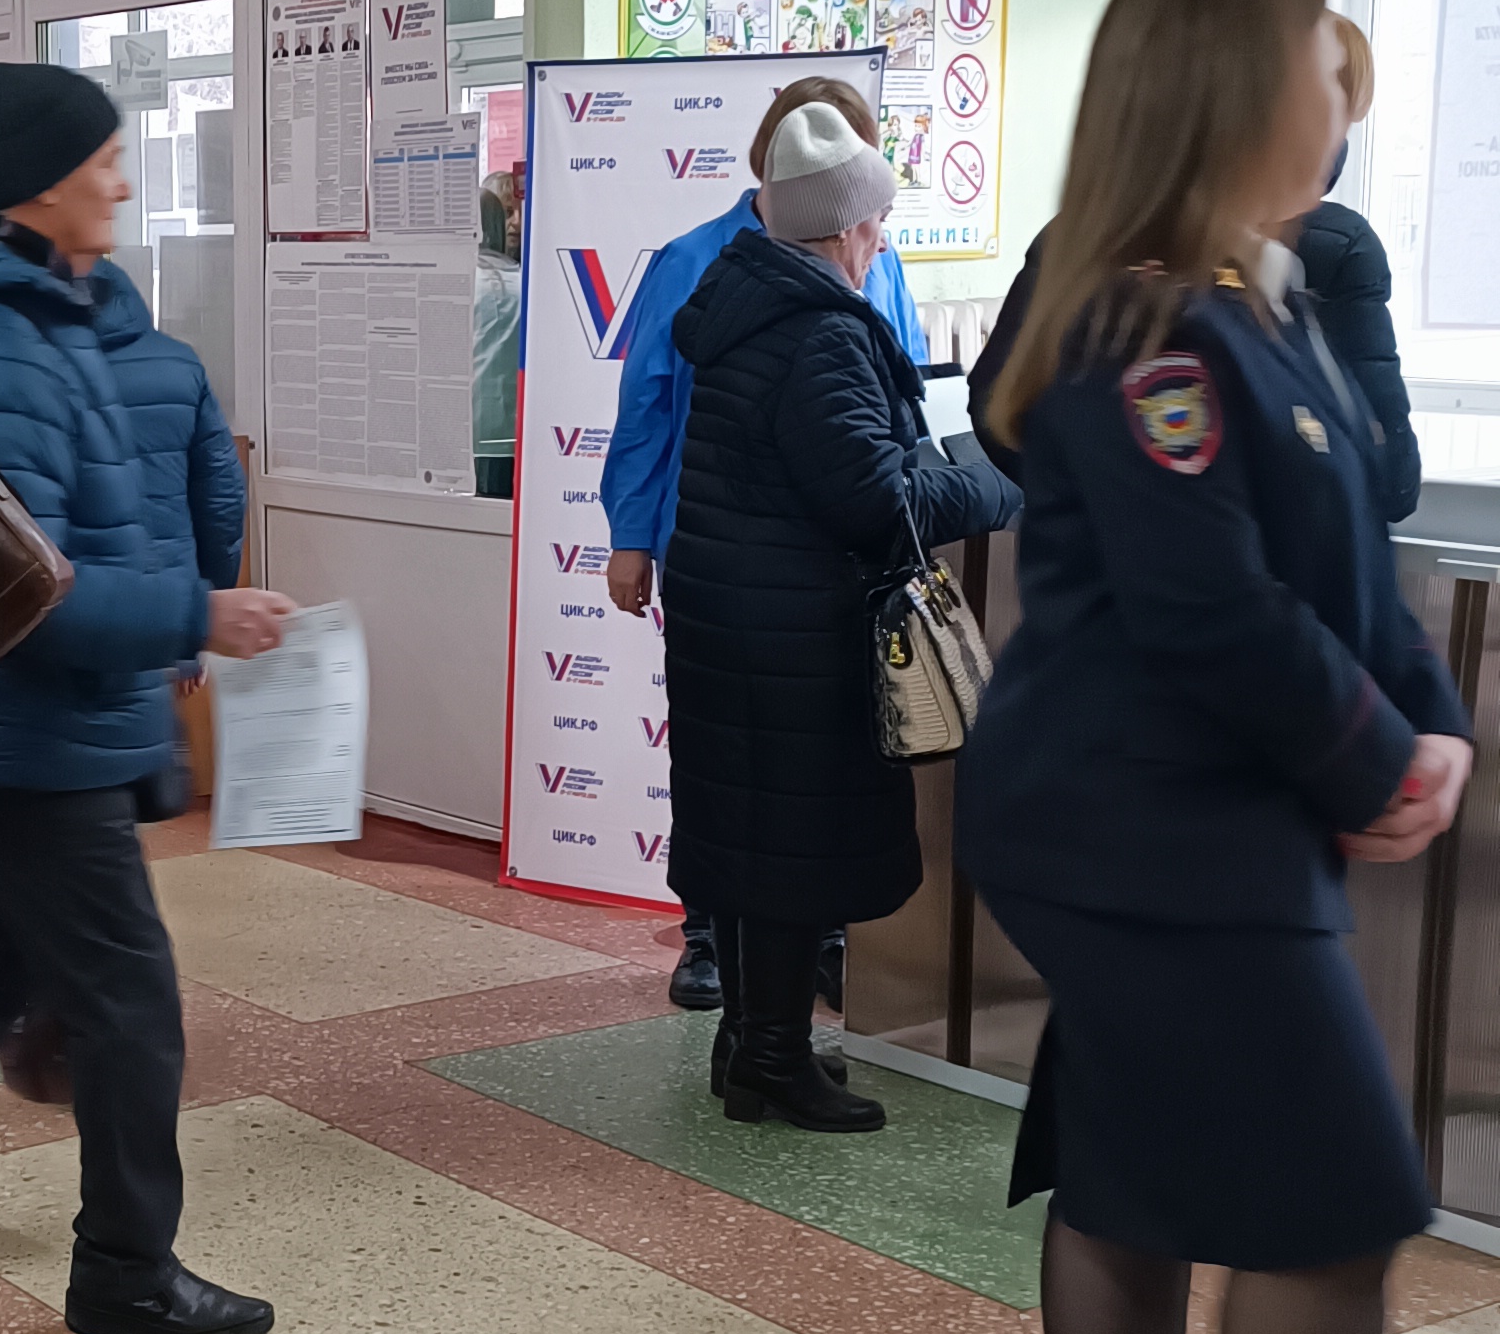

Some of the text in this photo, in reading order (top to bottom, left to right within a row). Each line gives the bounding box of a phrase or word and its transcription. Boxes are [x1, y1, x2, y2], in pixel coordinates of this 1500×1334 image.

[674, 96, 723, 111] ЦИК.РФ
[570, 157, 617, 172] ЦИК.РФ
[560, 603, 605, 619] ЦИК.РФ
[553, 715, 598, 731] ЦИК.РФ
[552, 829, 597, 846] ЦИК.РФ
